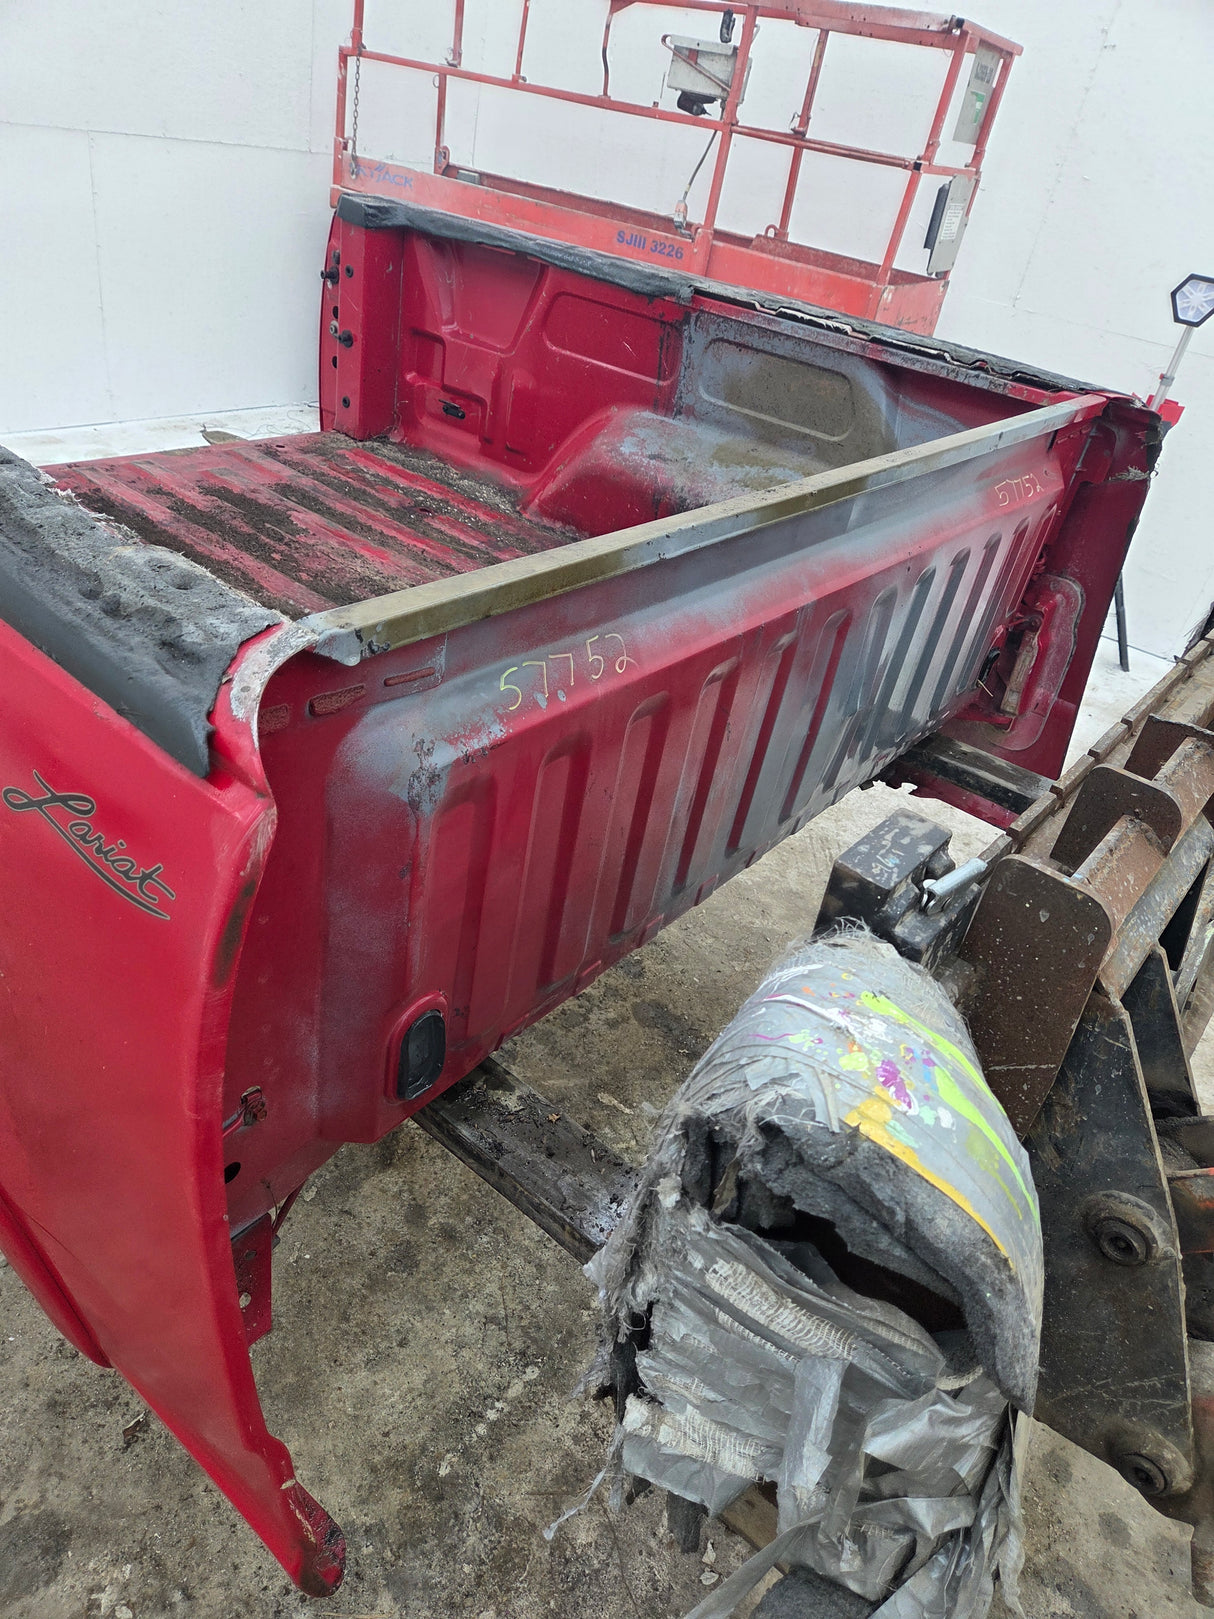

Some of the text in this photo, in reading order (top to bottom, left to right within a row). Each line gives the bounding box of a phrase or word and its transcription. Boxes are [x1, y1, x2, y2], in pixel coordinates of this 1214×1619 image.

[616, 230, 684, 260] SJIII 3226
[994, 473, 1044, 507] 57752
[500, 633, 639, 710] 57752
[2, 768, 176, 920] Lariat
